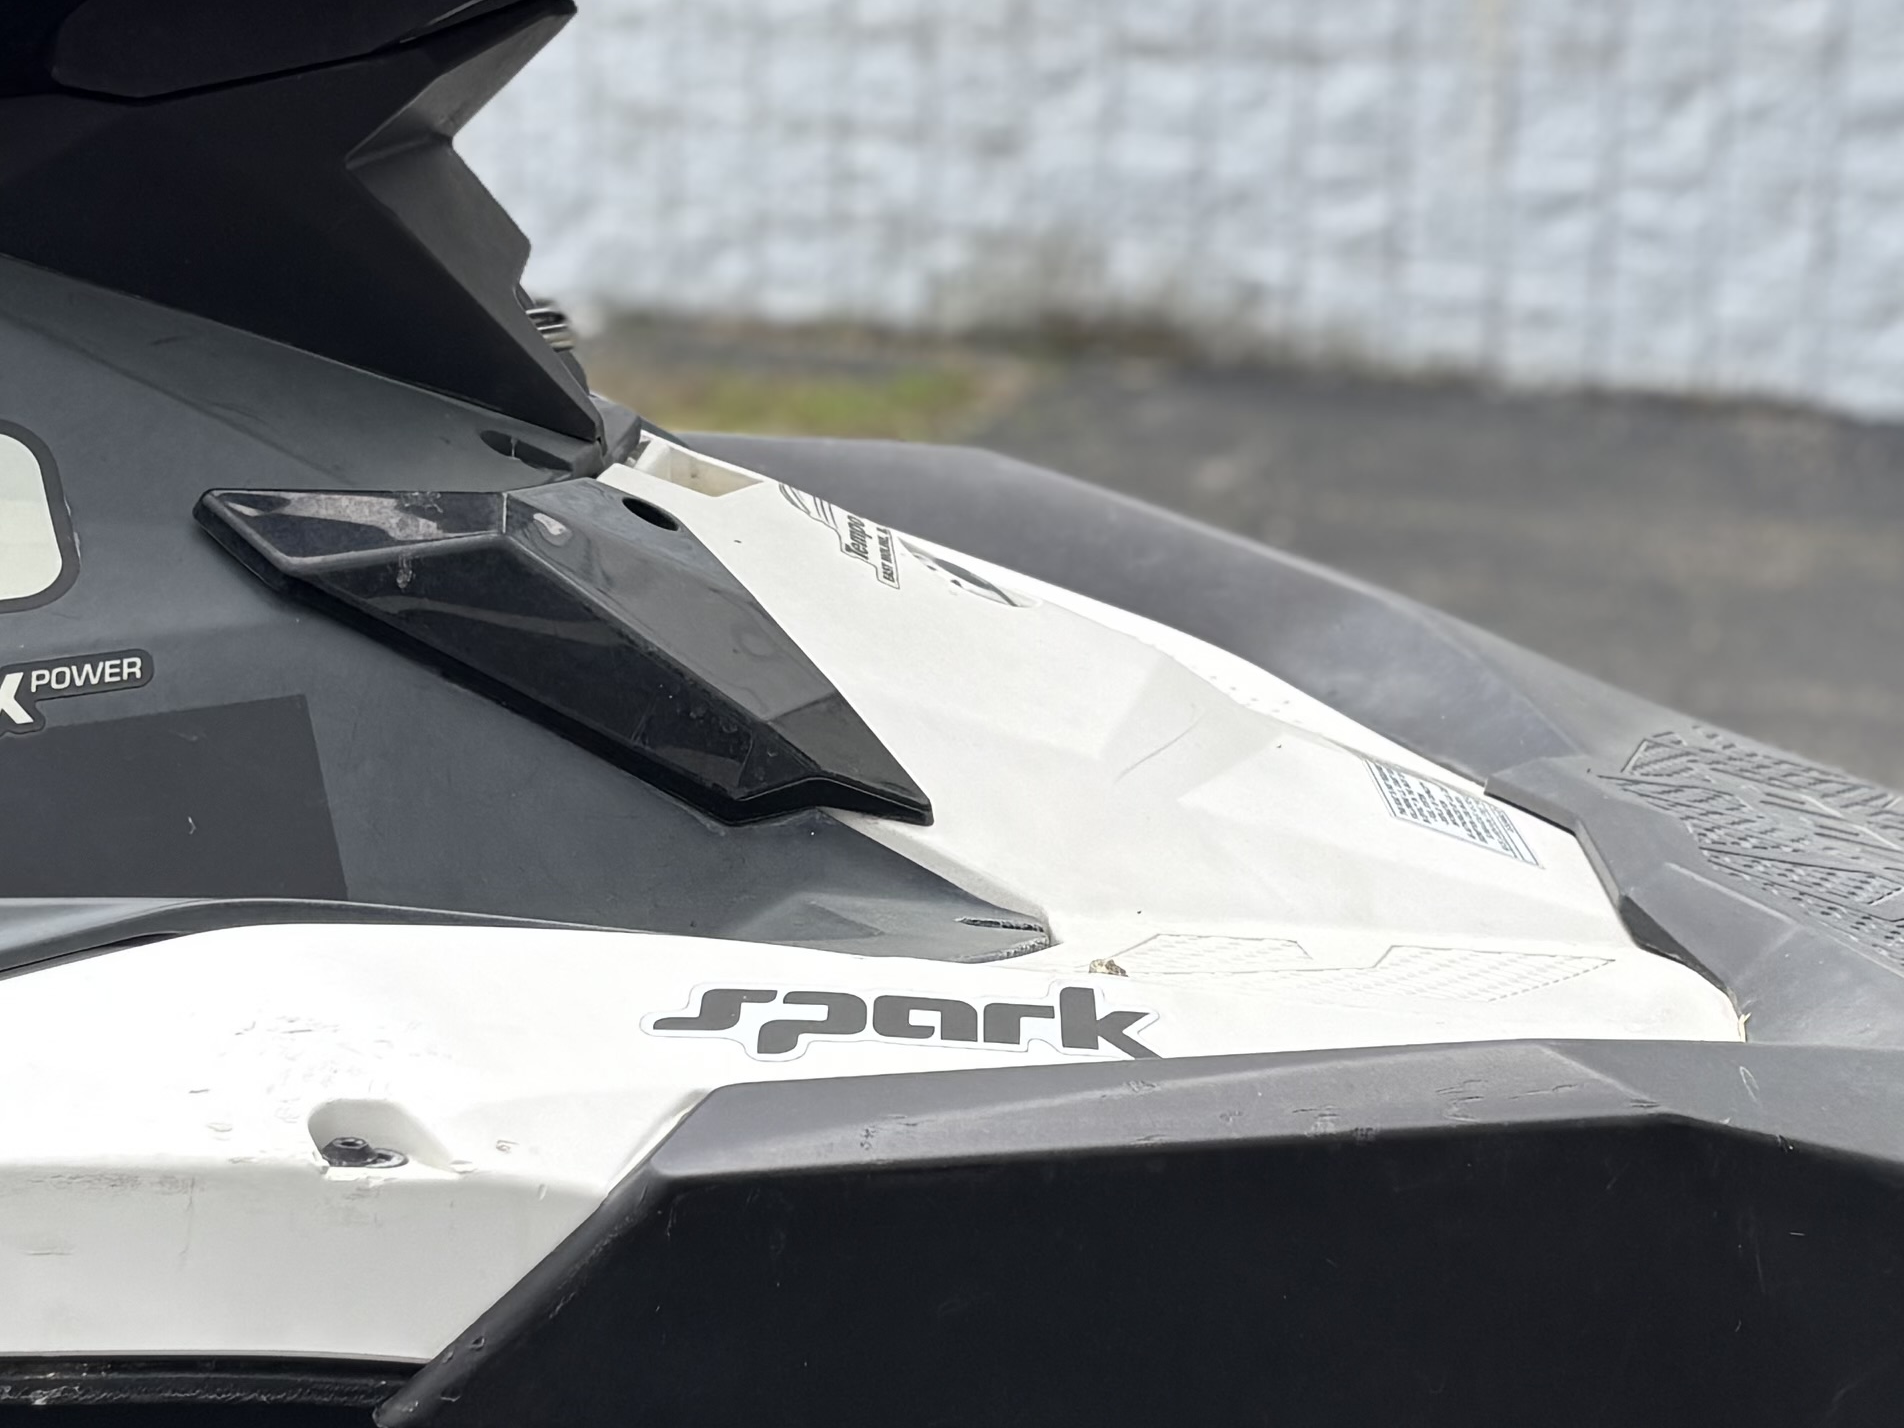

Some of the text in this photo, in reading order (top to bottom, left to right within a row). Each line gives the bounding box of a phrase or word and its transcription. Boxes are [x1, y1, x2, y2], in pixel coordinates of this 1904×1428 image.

[844, 514, 873, 561] Tempo
[881, 561, 895, 583] EAST
[30, 656, 142, 693] POWER
